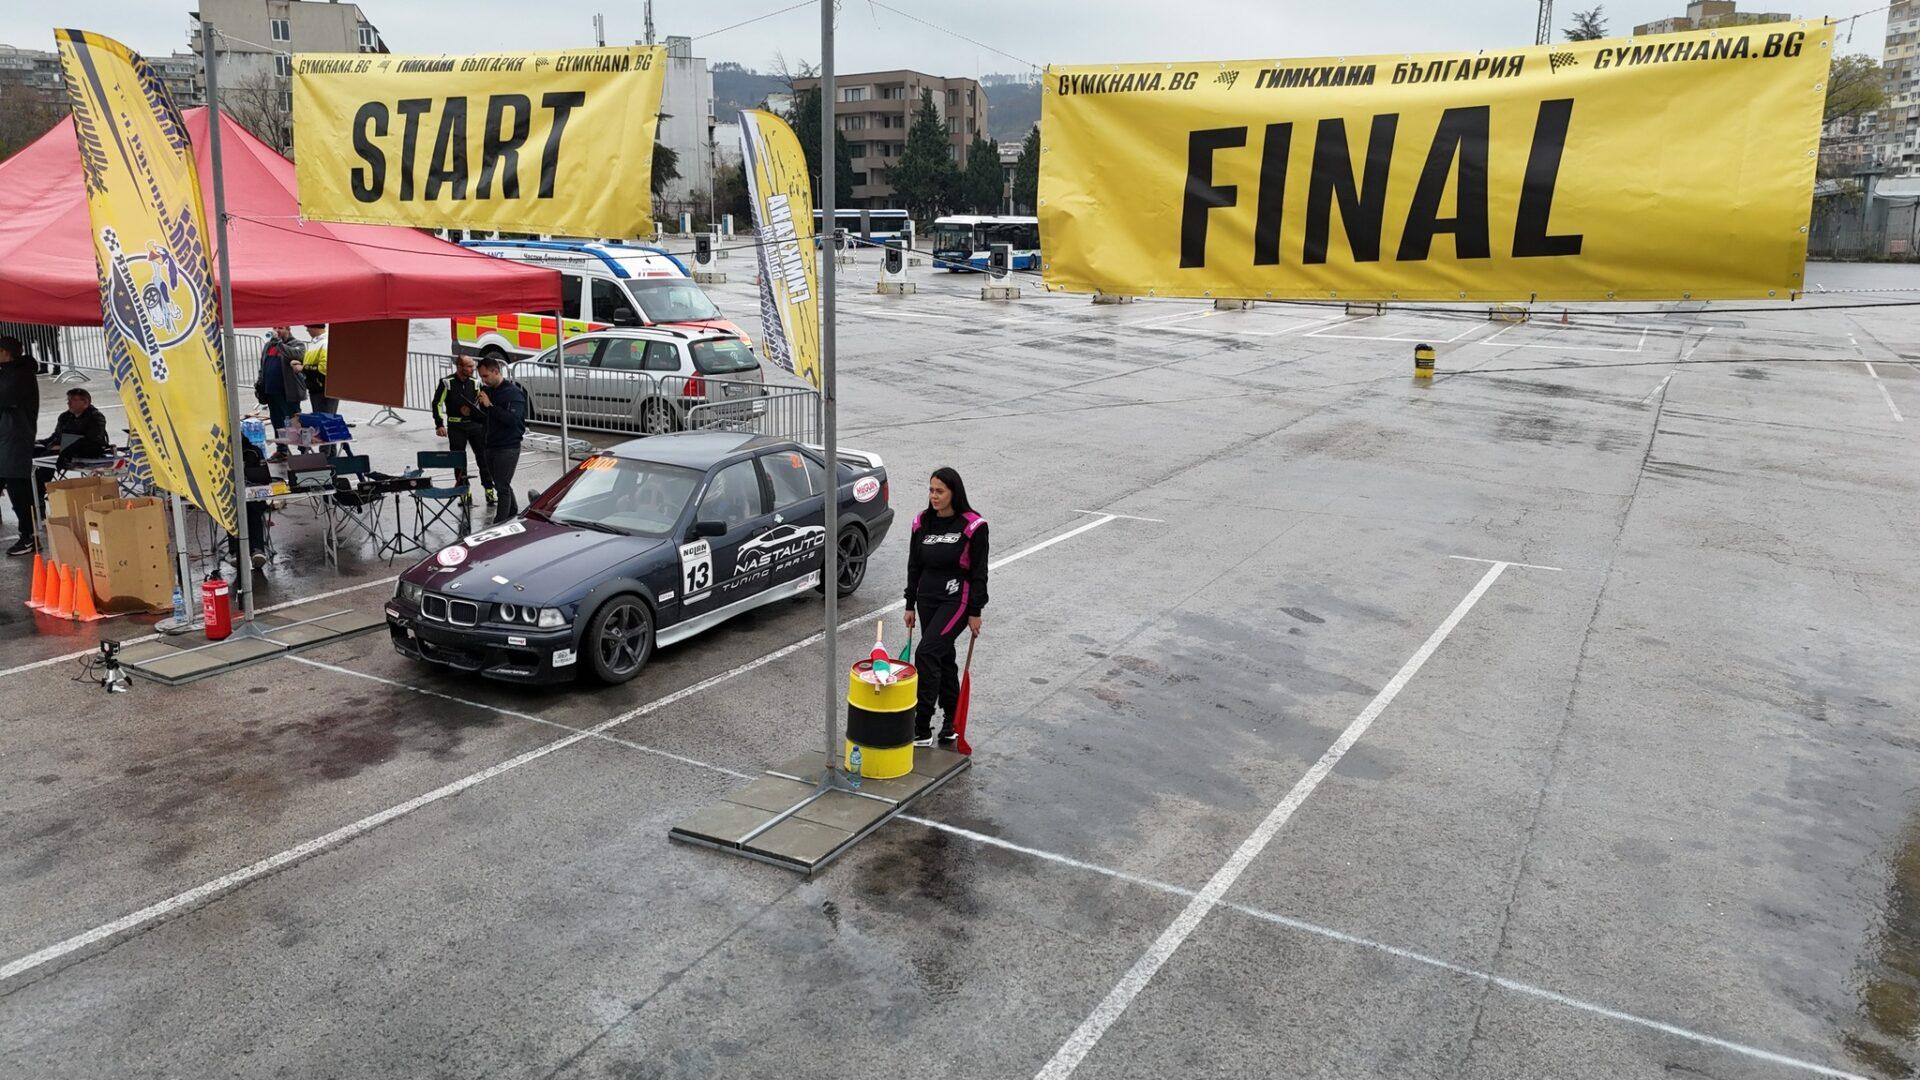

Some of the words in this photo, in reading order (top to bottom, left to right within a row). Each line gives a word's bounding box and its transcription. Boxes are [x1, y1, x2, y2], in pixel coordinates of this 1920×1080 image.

[396, 58, 456, 73] ГИМКХАНА
[555, 54, 653, 72] GYMKHANA.BG
[1594, 31, 1805, 69] GYMKHANA.BG
[299, 59, 372, 74] GYMKHANA.BG
[1254, 64, 1377, 89] ГИМКХАНА
[1391, 55, 1526, 84] БЪЛГАРИЯ
[1058, 71, 1199, 96] GYMKHANA.BG
[351, 91, 586, 203] START
[1179, 98, 1584, 268] FINAL
[683, 543, 707, 556] NOLAN
[733, 532, 825, 576] NASTAUTO
[687, 562, 709, 592] 13
[722, 569, 770, 591] TUNING
[775, 551, 815, 572] PARTS
